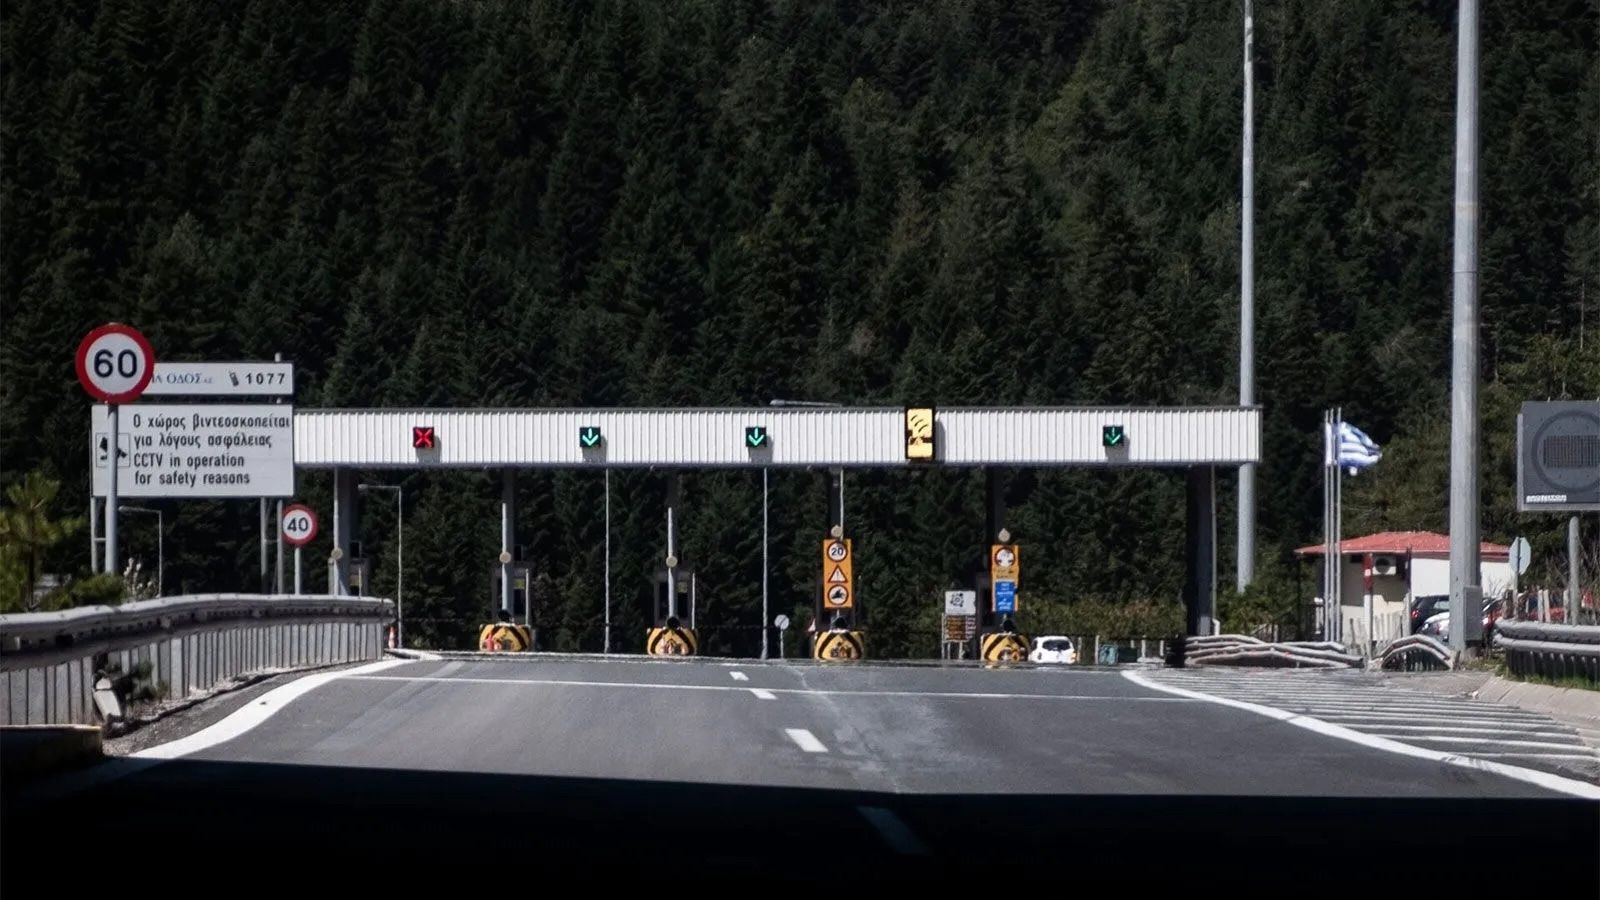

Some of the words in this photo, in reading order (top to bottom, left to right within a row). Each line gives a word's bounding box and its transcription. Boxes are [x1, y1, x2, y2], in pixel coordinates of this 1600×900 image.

[94, 349, 138, 378] 60
[166, 373, 202, 384] ΟΔΟΣ
[245, 372, 286, 385] 1077
[148, 413, 186, 431] χώρος
[192, 413, 290, 429] βιντεοσκοπείται
[134, 436, 152, 448] για
[159, 433, 201, 449] λόγους
[208, 433, 271, 448] ασφάλειας
[133, 453, 163, 467] CCTV
[169, 453, 181, 467] in
[187, 453, 245, 470] operation
[135, 471, 151, 485] for
[159, 471, 196, 488] safety
[203, 473, 250, 485] reasons
[287, 517, 309, 532] 40
[831, 547, 844, 556] 20
